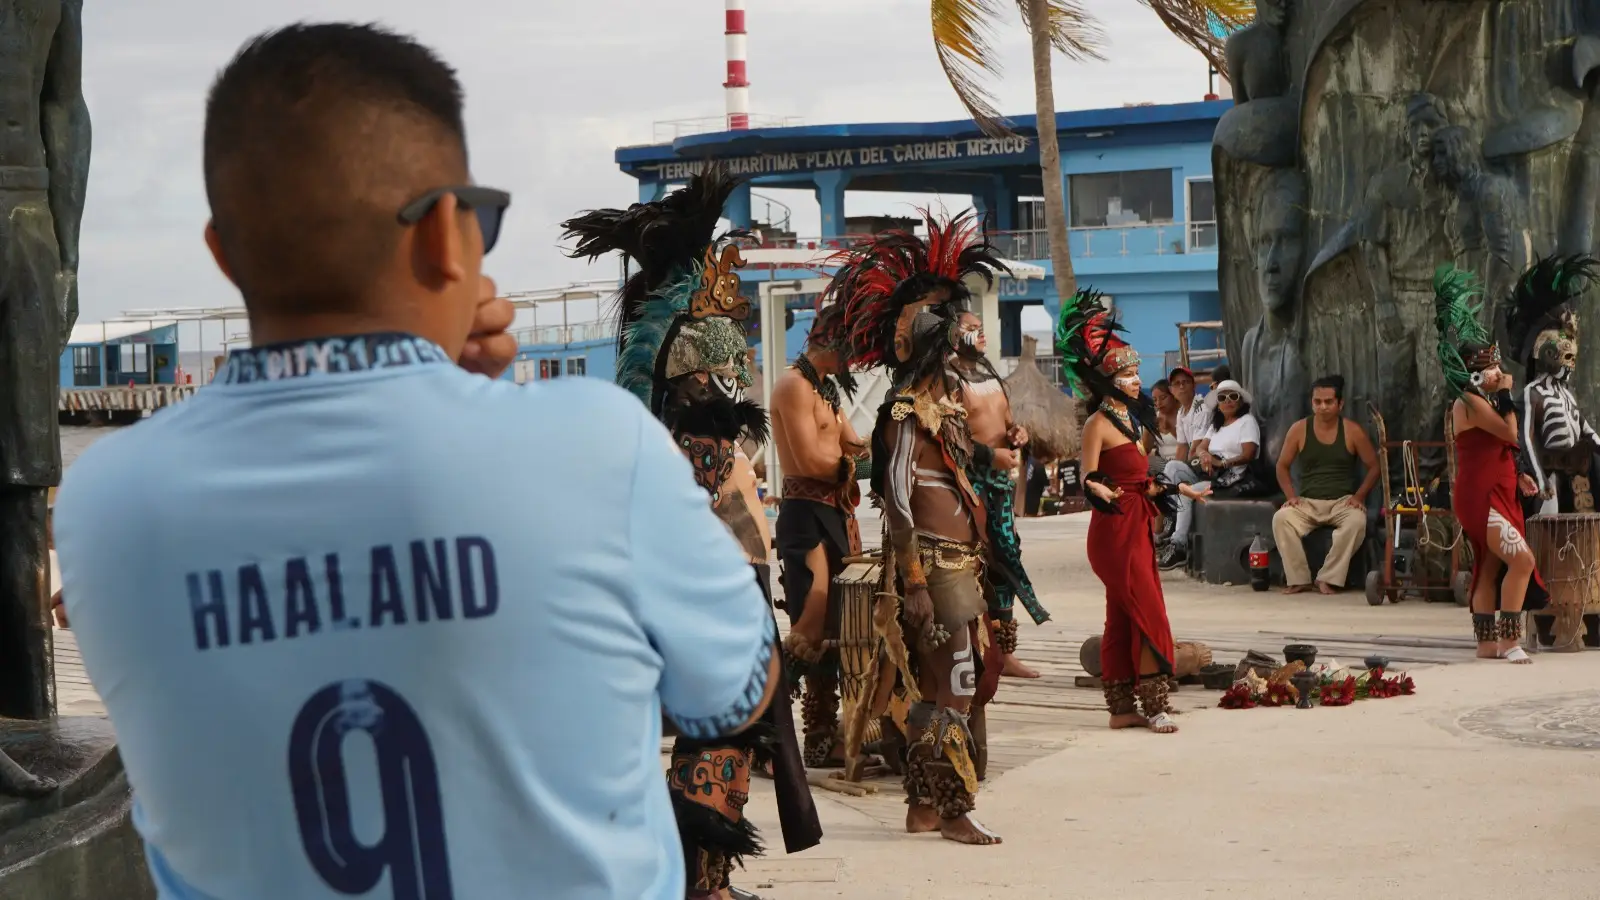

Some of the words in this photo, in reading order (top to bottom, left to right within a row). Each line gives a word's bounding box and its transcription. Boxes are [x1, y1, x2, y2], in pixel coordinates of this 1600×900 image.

[658, 160, 722, 179] TERMIN
[806, 149, 854, 168] PLAYA
[860, 147, 888, 164] DEL
[185, 535, 500, 650] HAALAND
[286, 678, 455, 900] 9
